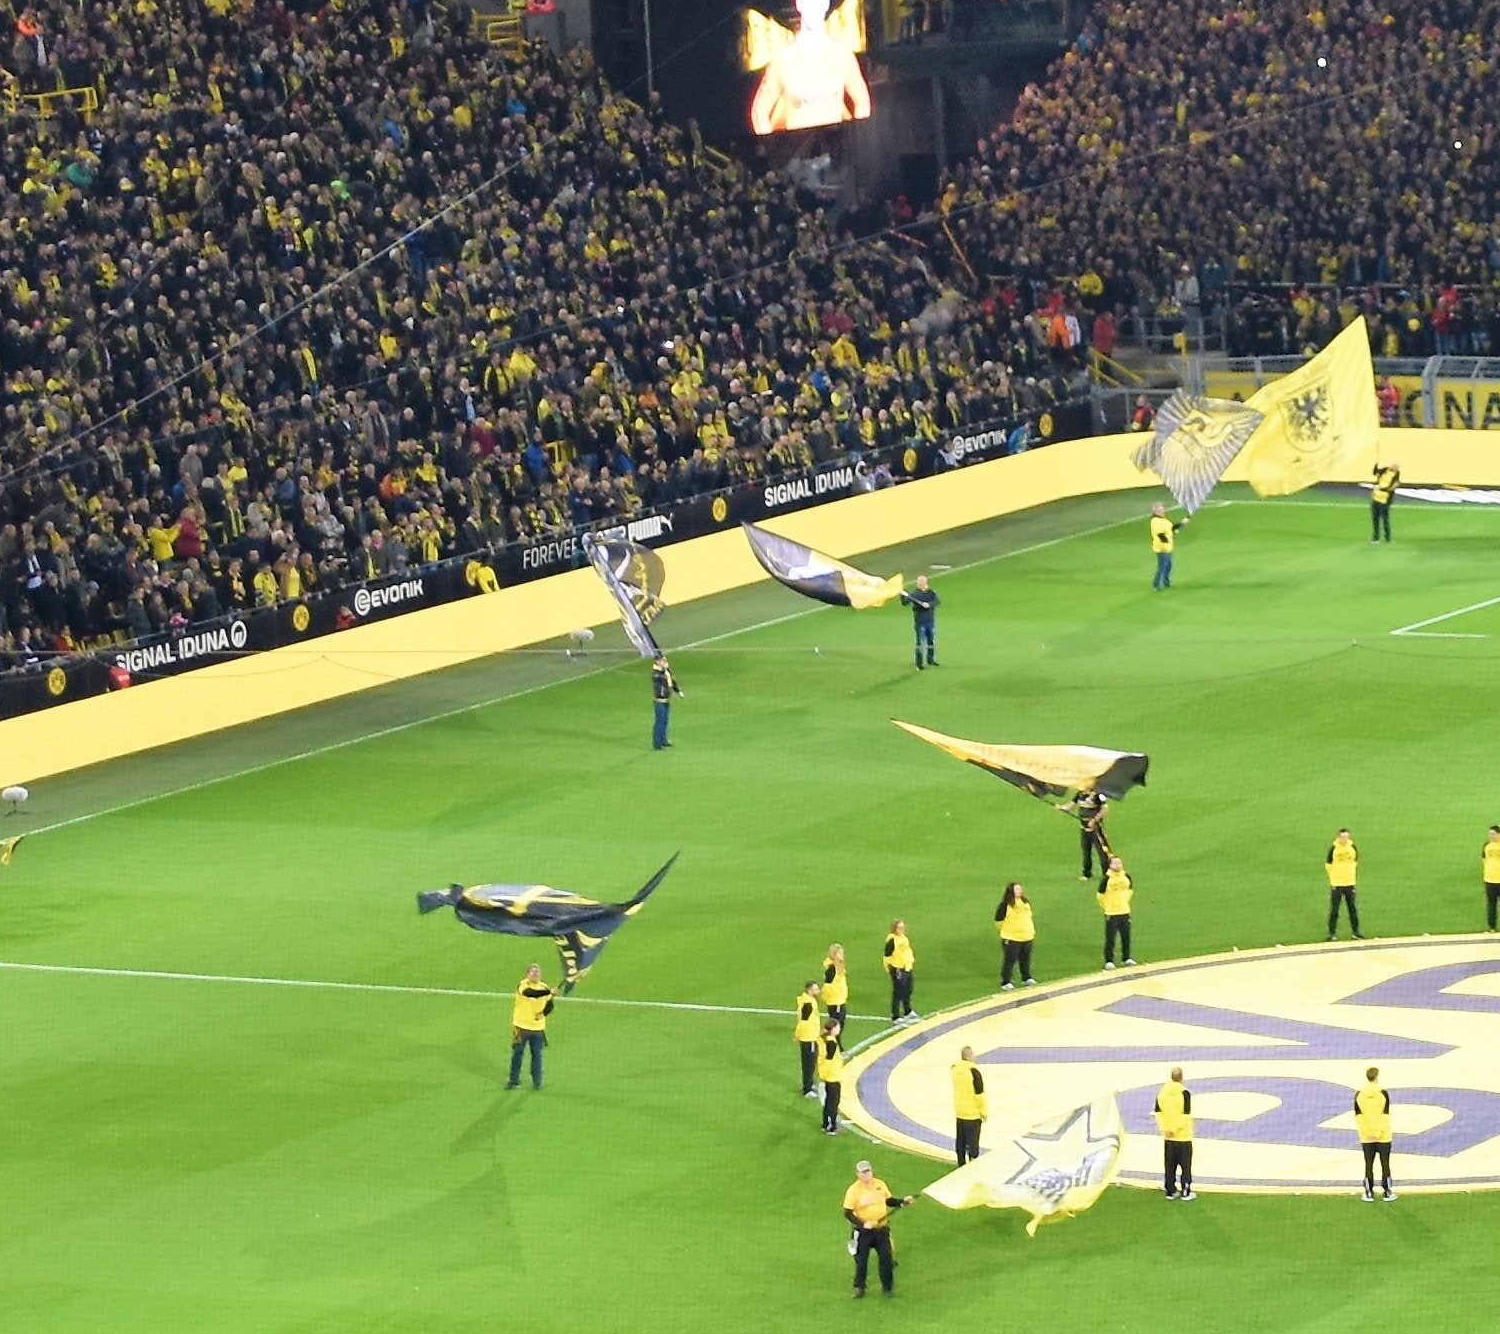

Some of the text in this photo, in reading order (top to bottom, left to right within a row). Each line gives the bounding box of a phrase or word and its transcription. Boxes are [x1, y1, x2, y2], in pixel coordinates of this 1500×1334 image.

[764, 468, 853, 507] SIGNAL IDUNA
[371, 579, 424, 608] EVONIK
[115, 628, 229, 673] SIGNAL IDUNA
